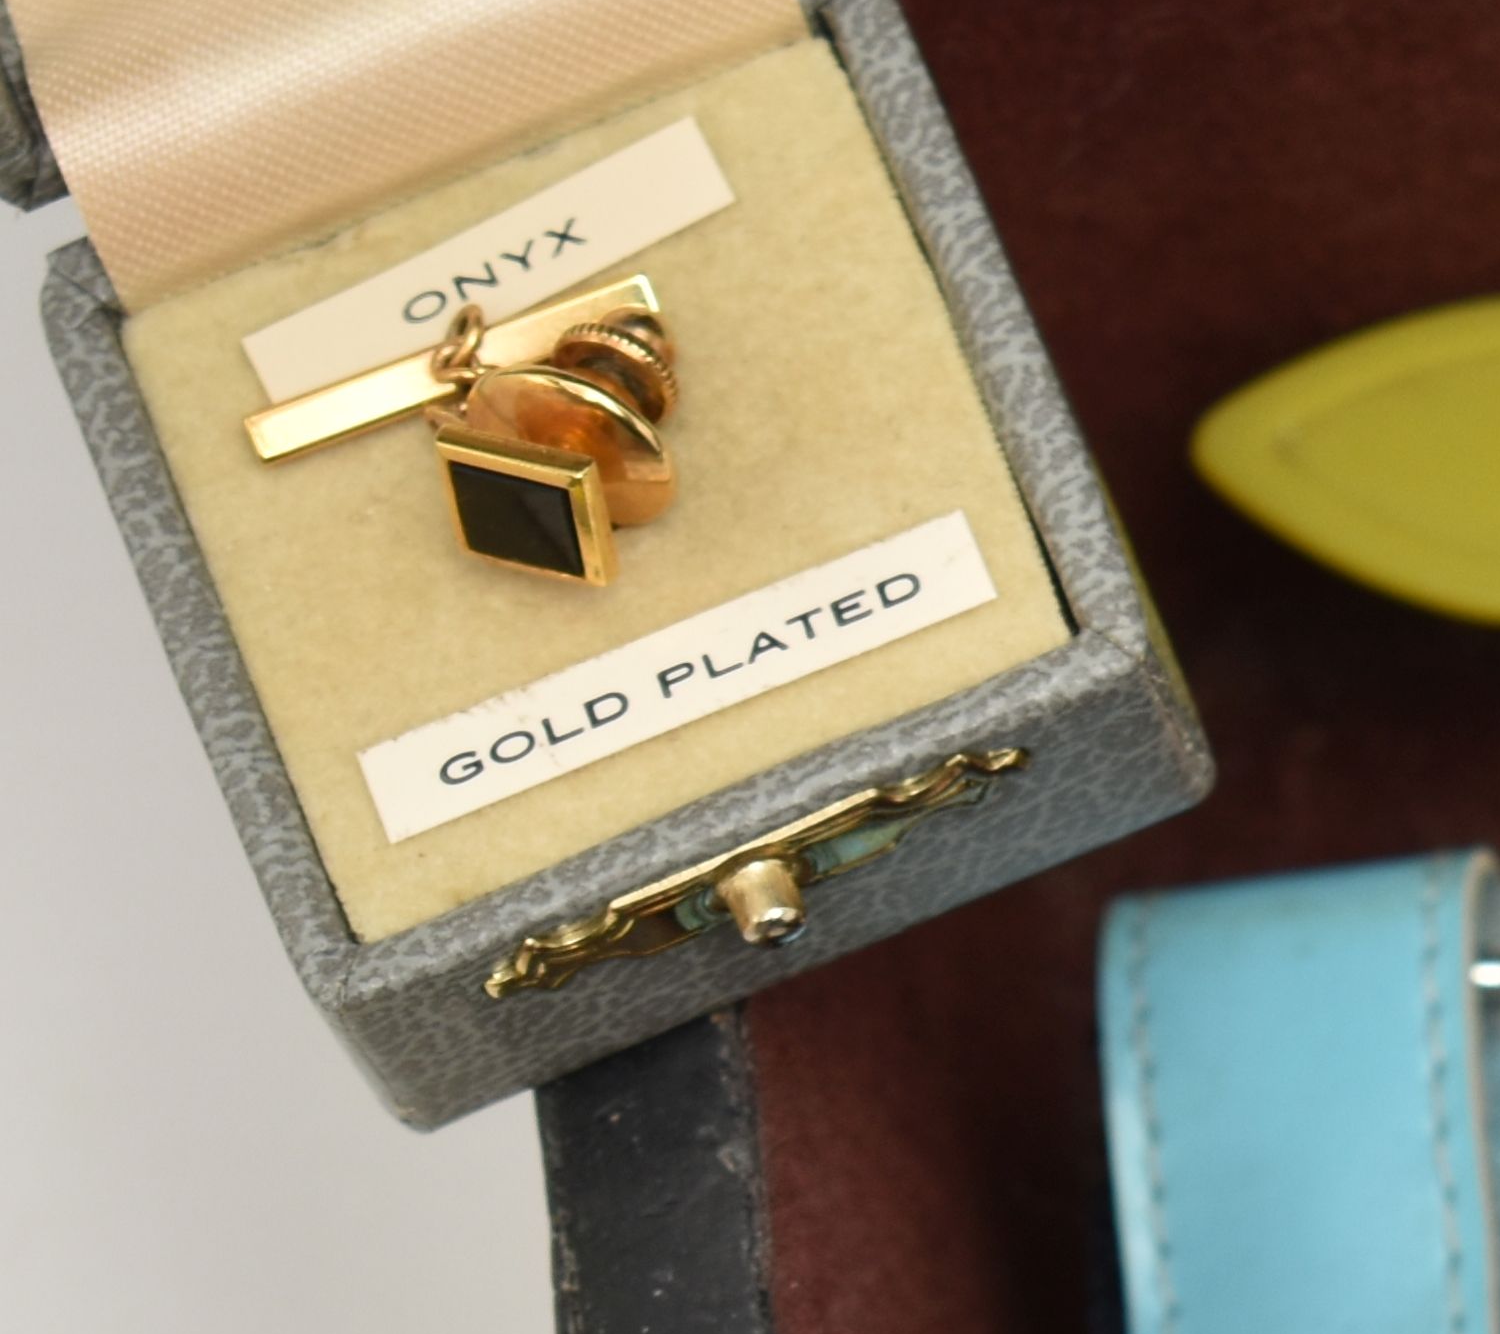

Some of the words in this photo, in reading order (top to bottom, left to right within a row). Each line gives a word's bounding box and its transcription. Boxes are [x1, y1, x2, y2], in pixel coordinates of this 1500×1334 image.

[401, 217, 590, 327] ONYX
[437, 691, 631, 787] GOLD
[656, 571, 923, 699] PLATED
